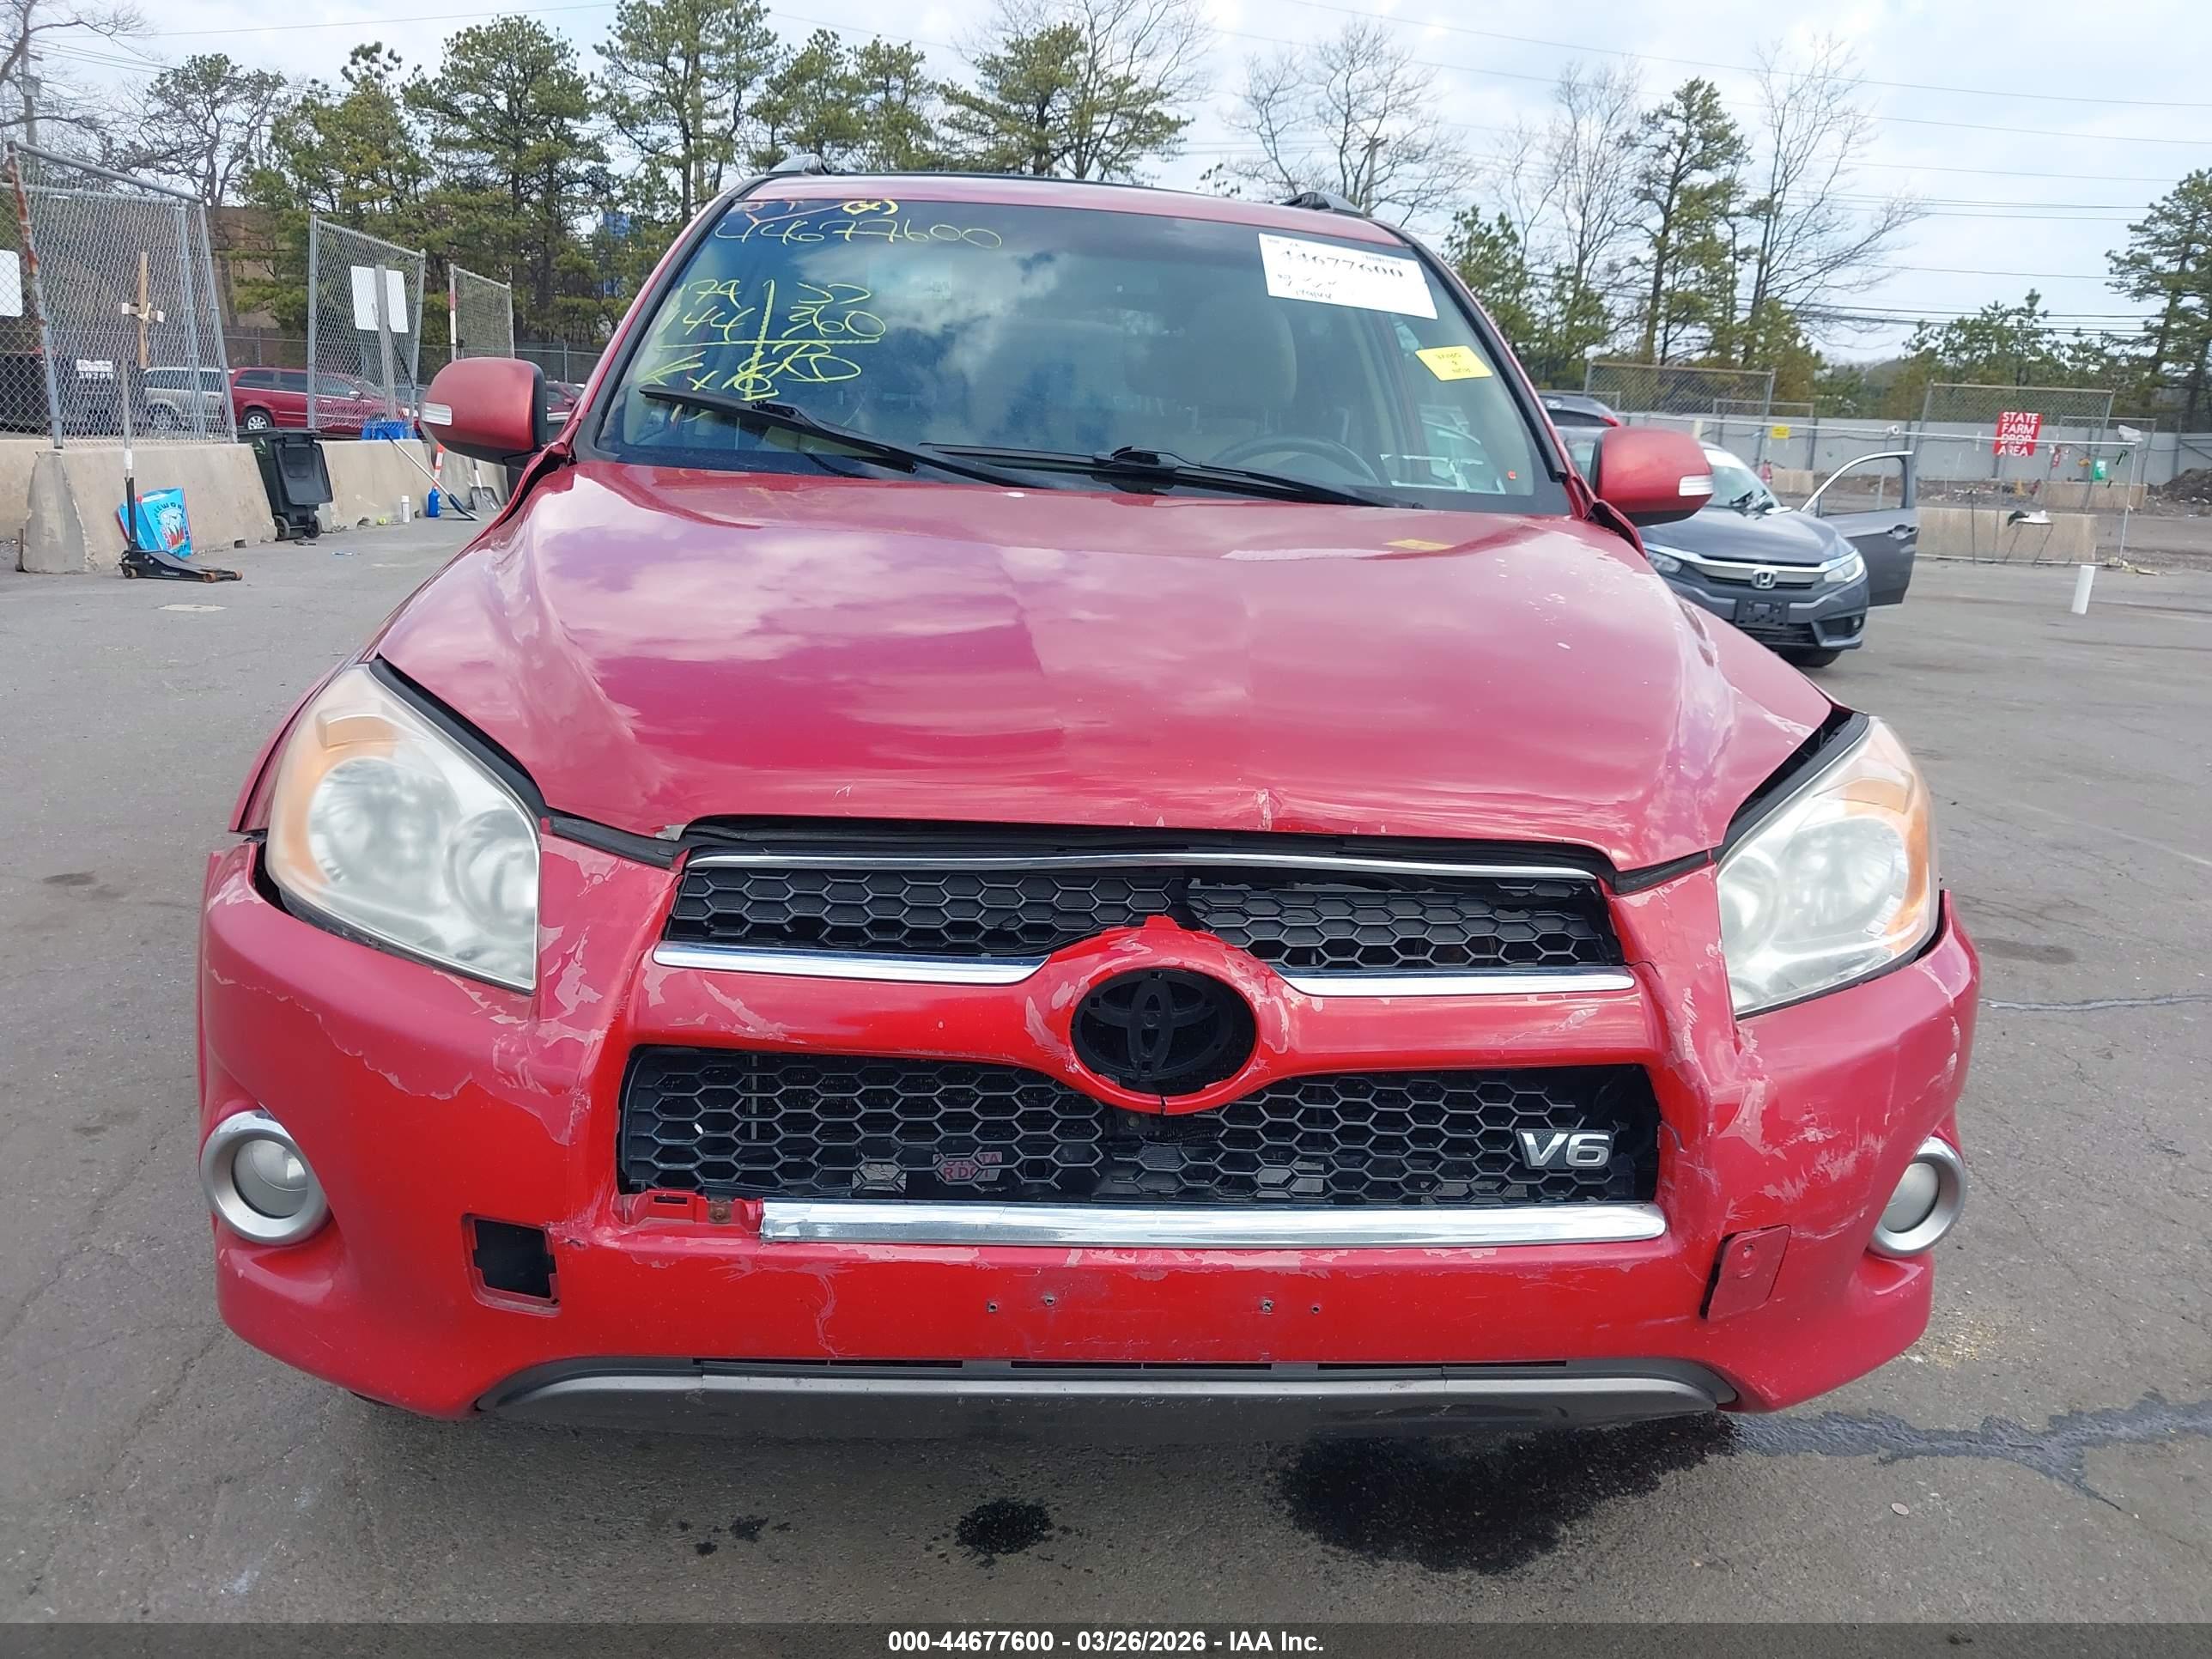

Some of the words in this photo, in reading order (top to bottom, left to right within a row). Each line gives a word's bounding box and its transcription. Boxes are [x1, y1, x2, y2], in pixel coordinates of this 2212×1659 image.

[2002, 412, 2039, 423] STATE
[2002, 422, 2035, 434] FARM
[2000, 434, 2032, 445] DROP
[1997, 445, 2028, 456] AREA
[1520, 1133, 1611, 1167] V6
